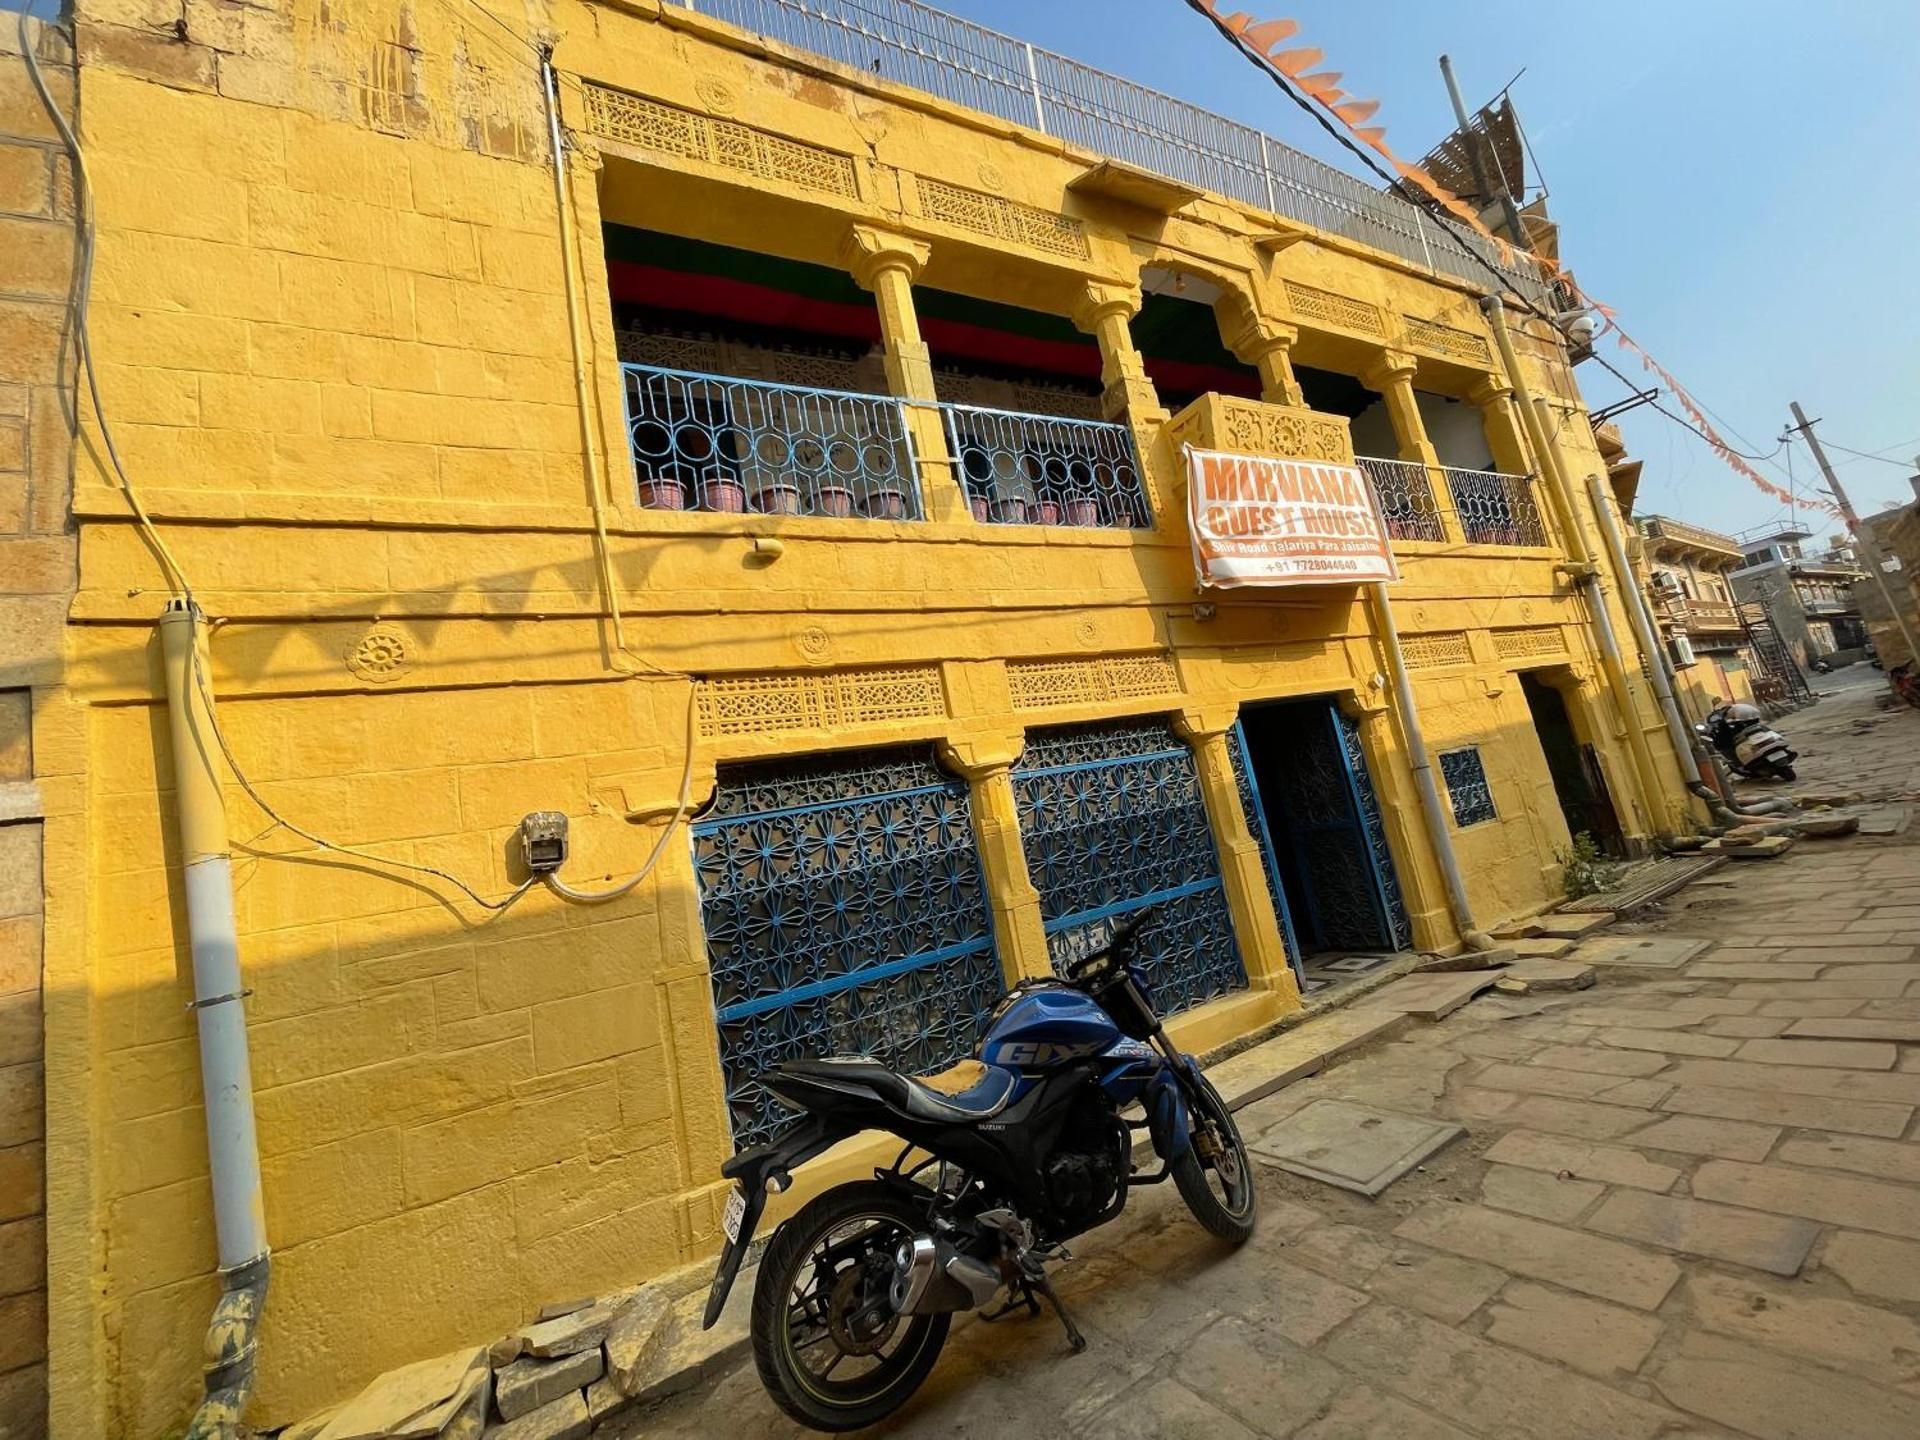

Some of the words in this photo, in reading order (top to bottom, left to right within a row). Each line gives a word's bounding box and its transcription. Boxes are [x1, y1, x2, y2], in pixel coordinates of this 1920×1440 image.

[1202, 457, 1365, 507] MIRVANA
[1207, 506, 1297, 536] GUEST
[1300, 507, 1378, 537] HOUSE
[1265, 561, 1290, 573] +91
